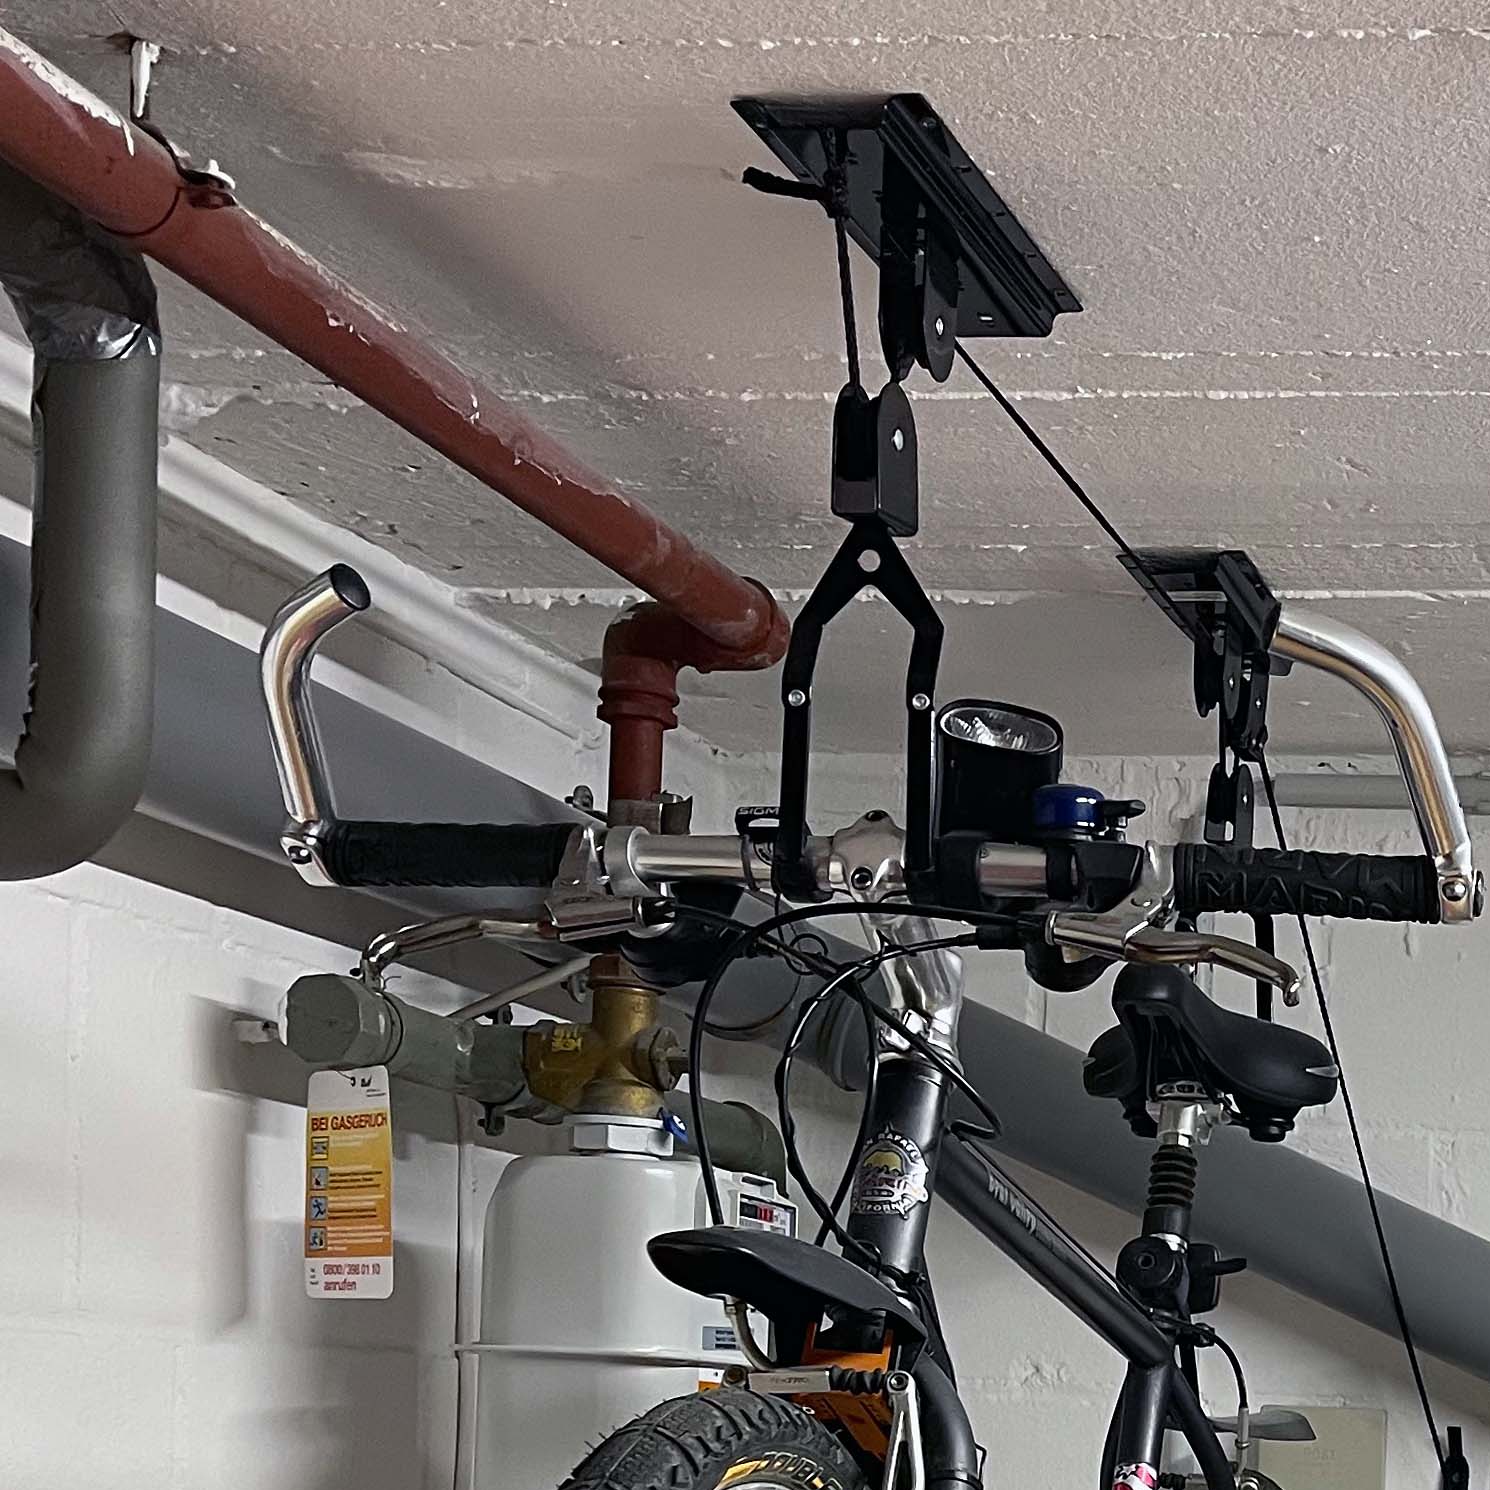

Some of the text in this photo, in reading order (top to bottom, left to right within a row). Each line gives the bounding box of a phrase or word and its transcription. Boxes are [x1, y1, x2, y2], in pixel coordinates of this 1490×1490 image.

[738, 807, 780, 815] SIGM
[311, 1111, 388, 1132] BEI GASGERUCH
